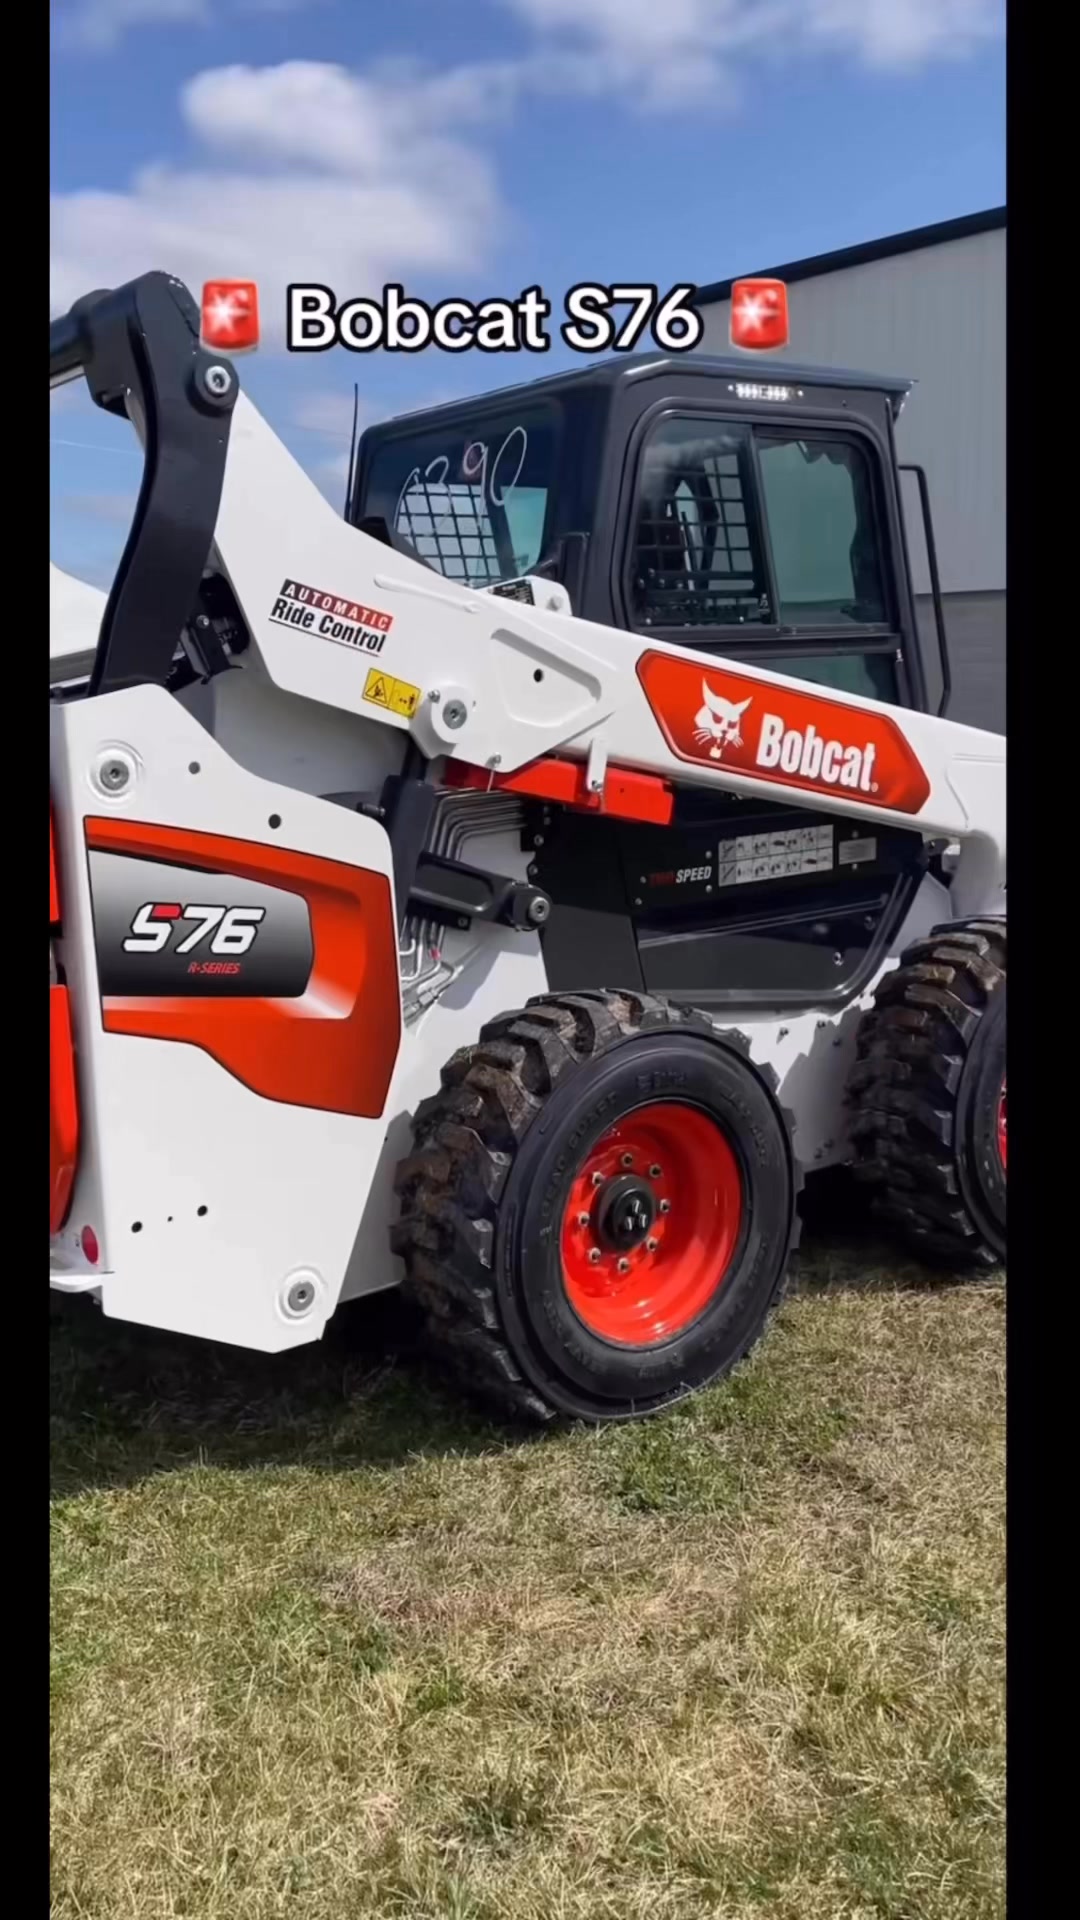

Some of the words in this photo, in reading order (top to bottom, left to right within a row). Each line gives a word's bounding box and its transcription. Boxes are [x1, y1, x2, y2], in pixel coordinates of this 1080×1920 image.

[270, 597, 316, 629] Ride
[318, 614, 387, 653] Control
[284, 583, 390, 630] AUTOMATIC
[756, 711, 876, 792] Bobcat
[675, 866, 712, 884] SPEED
[121, 902, 266, 955] S76
[187, 961, 241, 975] R-SERIES
